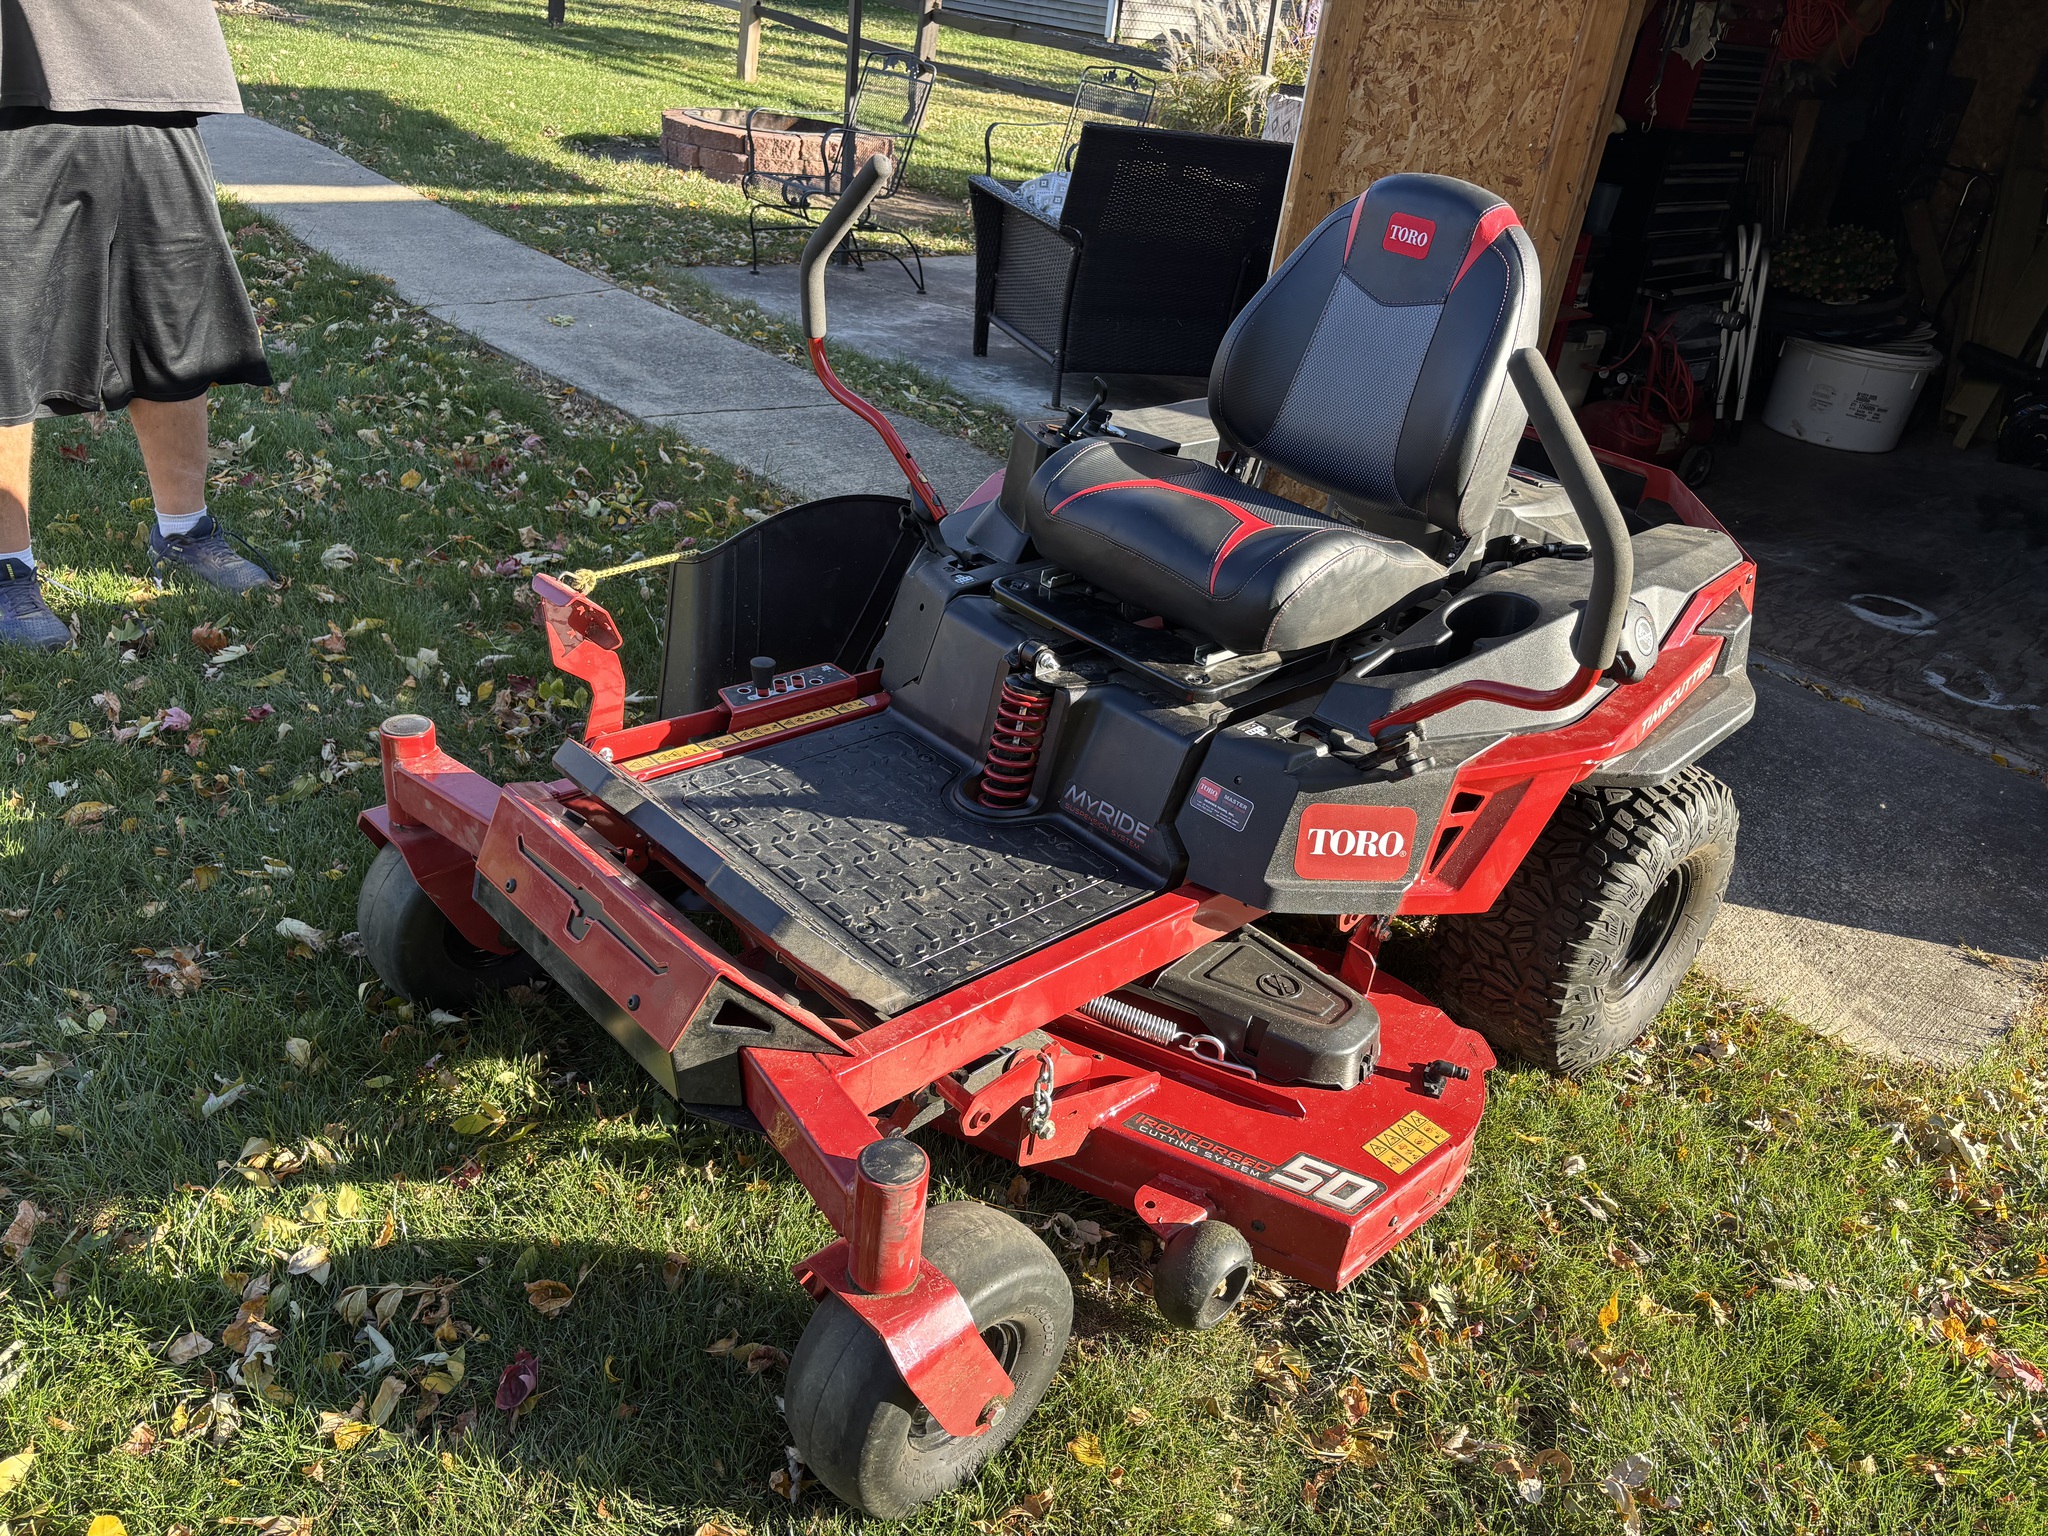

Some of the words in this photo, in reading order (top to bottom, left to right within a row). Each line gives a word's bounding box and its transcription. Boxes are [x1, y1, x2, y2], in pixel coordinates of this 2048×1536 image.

[1389, 224, 1428, 247] TORO
[1641, 655, 1714, 735] TIMECUTTER
[1200, 783, 1218, 798] TORO
[1223, 794, 1248, 811] MASTER
[1064, 802, 1110, 832] SUSPENSION
[1110, 829, 1141, 851] SYSTEM
[1138, 1125, 1199, 1154] CUTTING
[1202, 1150, 1262, 1179] SYSTEM
[1269, 1154, 1382, 1211] 50
